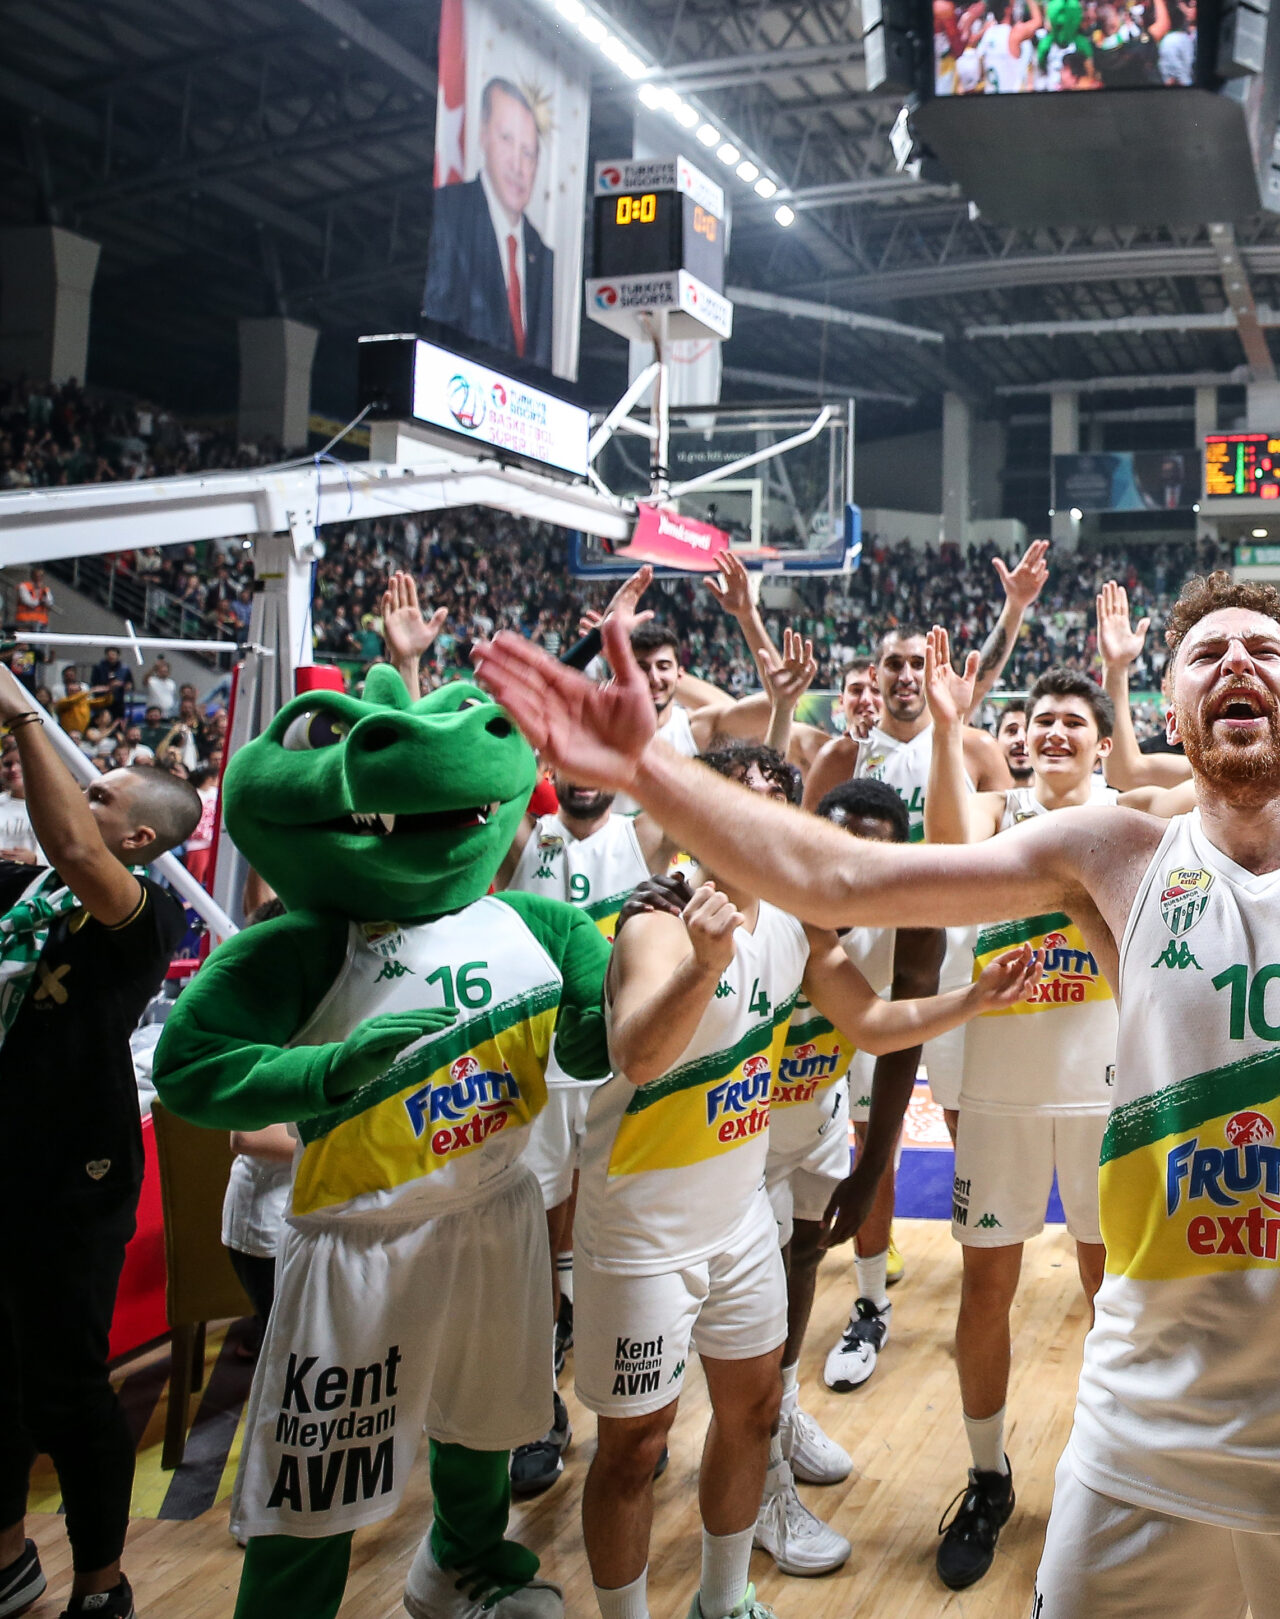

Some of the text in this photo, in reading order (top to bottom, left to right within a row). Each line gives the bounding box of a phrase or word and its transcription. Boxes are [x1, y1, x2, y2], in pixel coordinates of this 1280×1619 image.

[616, 194, 656, 225] 0:0
[896, 786, 926, 817] 4
[570, 873, 591, 903] 9
[1163, 890, 1199, 908] BURSASPOR
[1174, 903, 1200, 919] 1963
[425, 961, 492, 1009] 16
[748, 977, 772, 1018] 4
[431, 1110, 508, 1156] extra
[953, 1172, 971, 1197] ent
[615, 1335, 664, 1360] Kent
[281, 1345, 402, 1414] Kent
[612, 1370, 661, 1397] AVM
[266, 1436, 395, 1513] AVM
